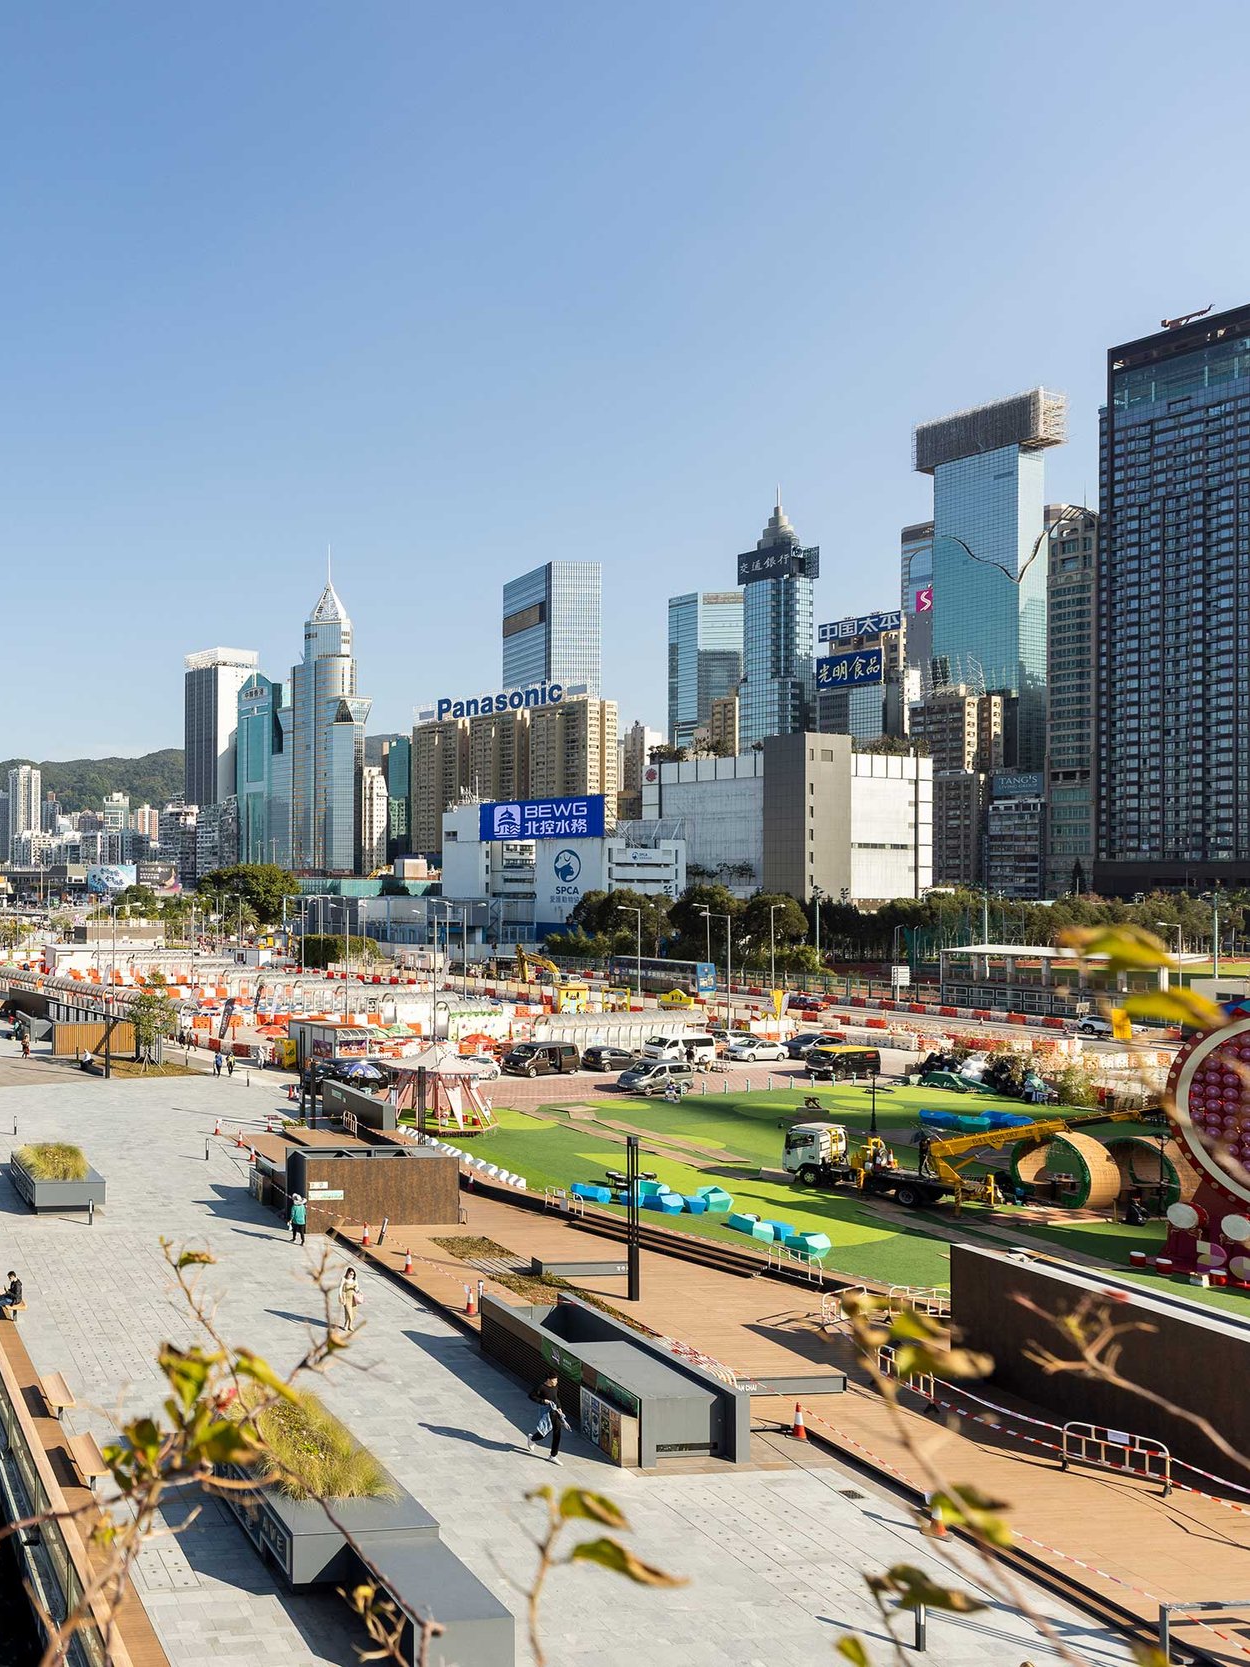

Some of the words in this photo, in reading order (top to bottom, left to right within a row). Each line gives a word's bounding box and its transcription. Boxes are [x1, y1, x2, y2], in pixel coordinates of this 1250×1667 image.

[819, 612, 900, 640] 中国太平
[818, 656, 880, 683] 光明食品
[437, 680, 563, 721] Panasonic
[999, 774, 1038, 785] TANG'S
[524, 802, 588, 818] BEWG
[524, 818, 588, 836] 北控水務
[555, 886, 579, 895] SPCA
